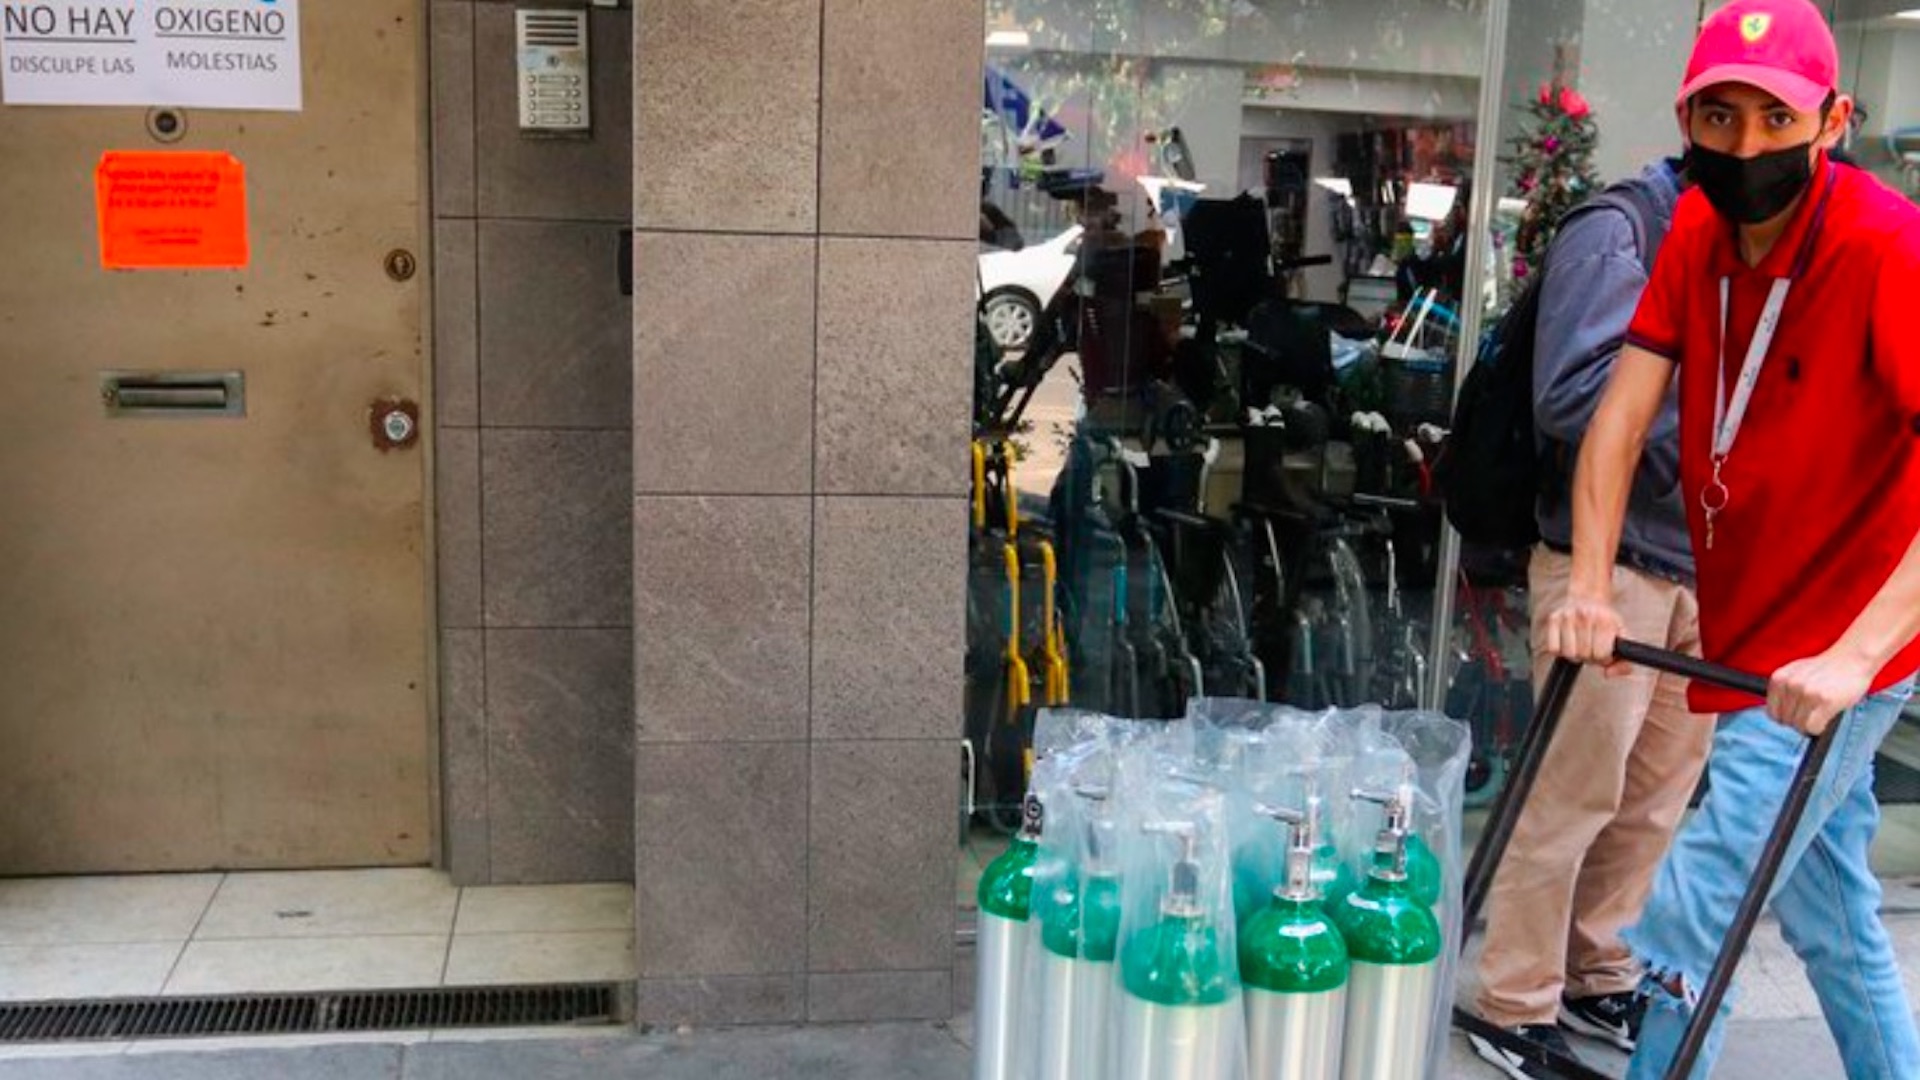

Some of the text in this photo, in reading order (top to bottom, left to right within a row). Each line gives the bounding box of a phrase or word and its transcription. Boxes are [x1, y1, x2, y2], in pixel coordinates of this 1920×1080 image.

[5, 5, 285, 35] NO HAY OXIGENO
[10, 51, 278, 74] DISCULPE LAS MOLESTIAS
